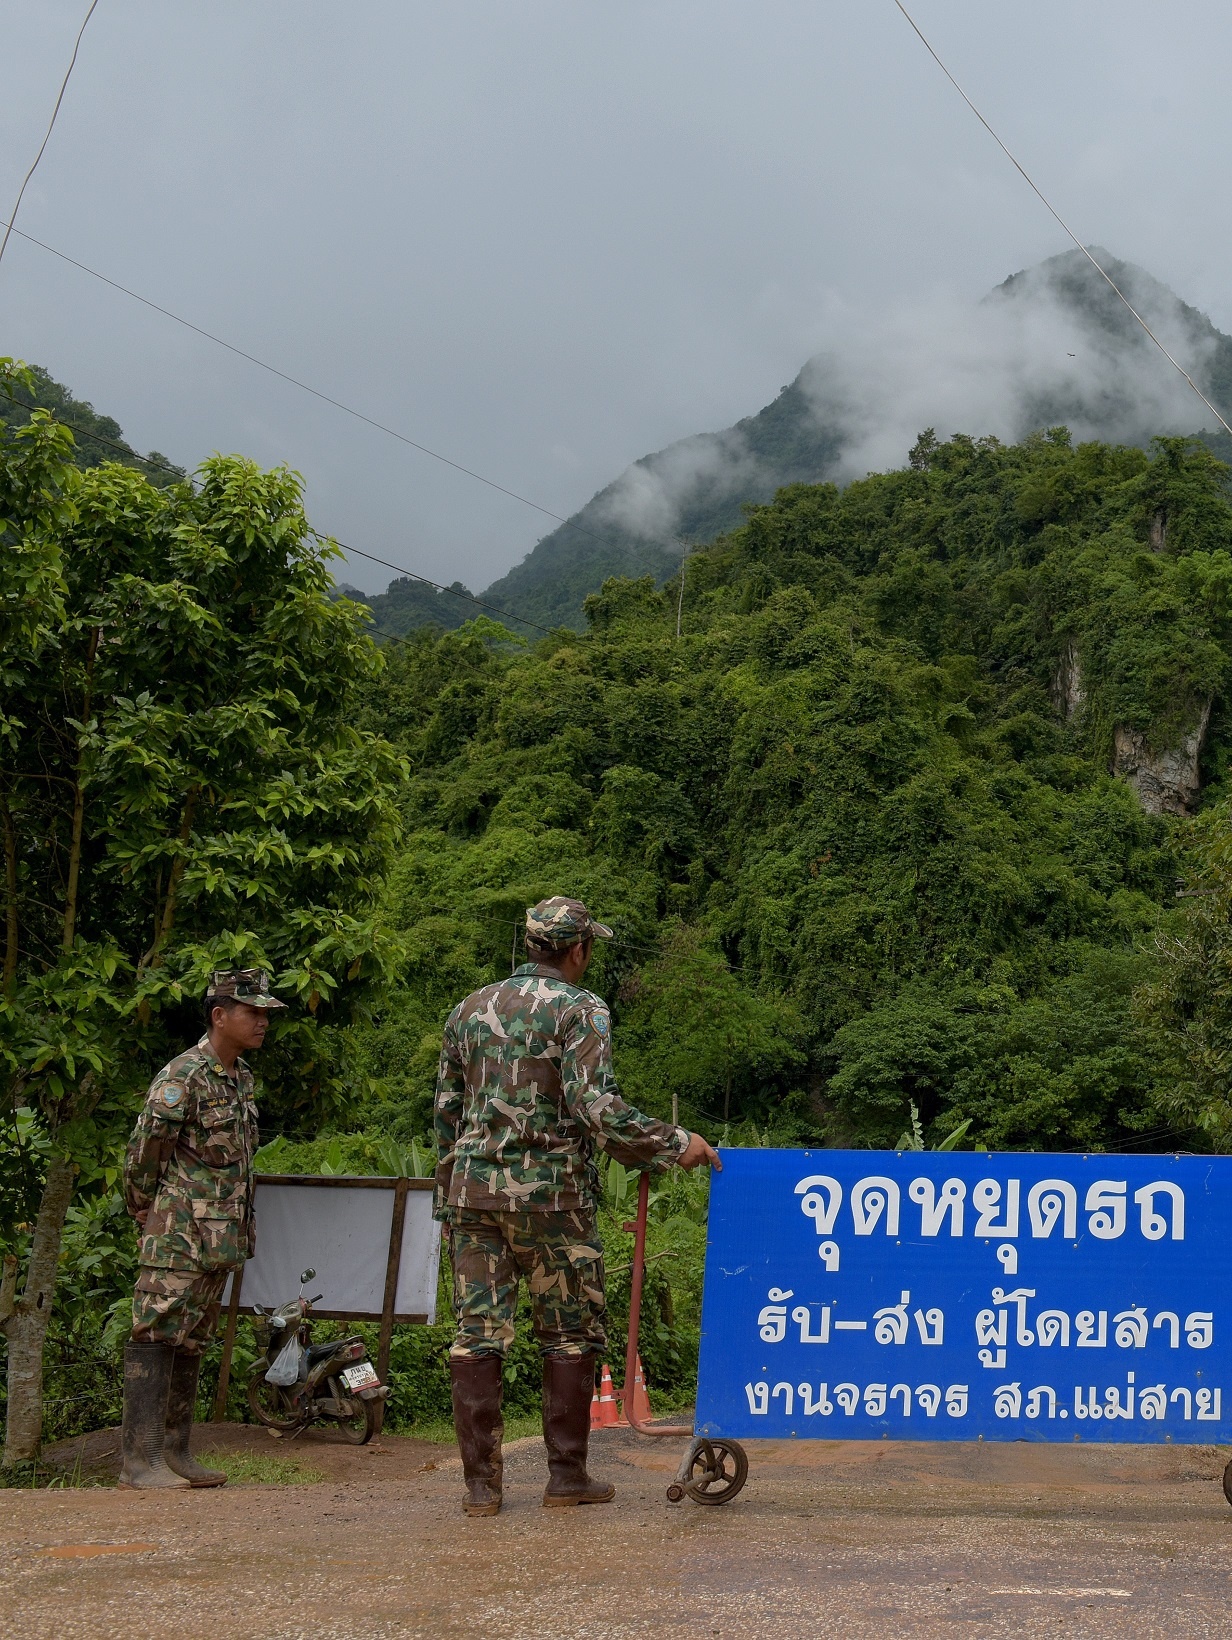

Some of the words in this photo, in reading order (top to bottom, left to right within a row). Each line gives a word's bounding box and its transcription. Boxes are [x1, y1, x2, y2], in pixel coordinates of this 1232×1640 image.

[793, 1174, 1185, 1275] จุดหยุดรถ
[757, 1287, 944, 1345] รับ-ส่ง
[975, 1287, 1213, 1369] ผู้โดยสาร
[744, 1381, 969, 1418] งานจราจร
[992, 1371, 1221, 1421] สภ.แม่สาย
